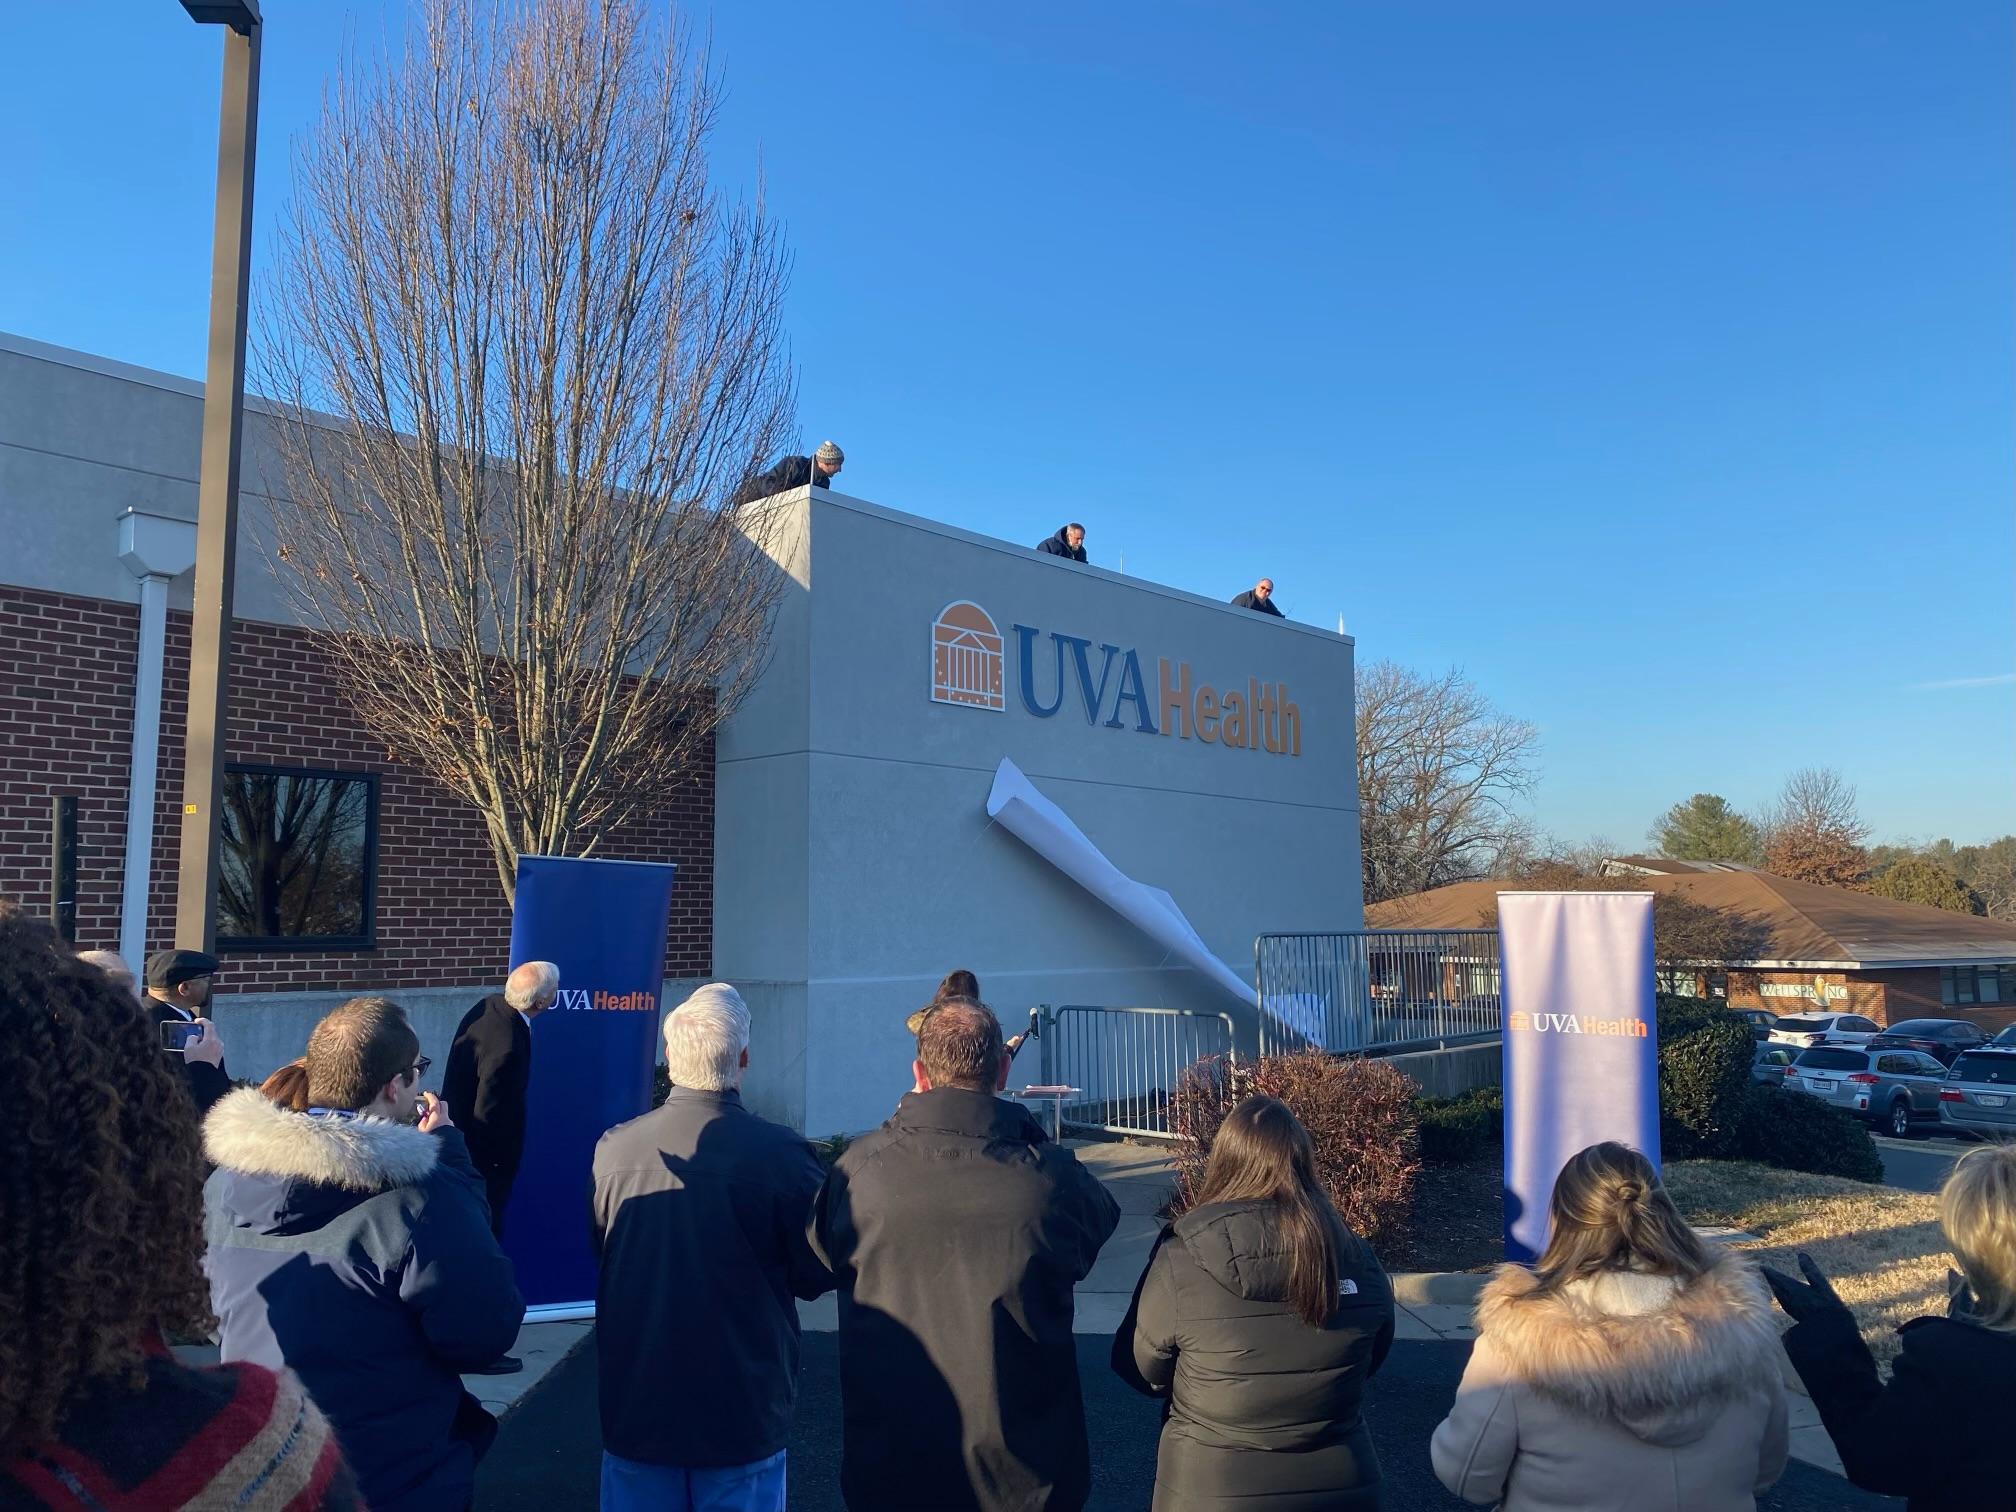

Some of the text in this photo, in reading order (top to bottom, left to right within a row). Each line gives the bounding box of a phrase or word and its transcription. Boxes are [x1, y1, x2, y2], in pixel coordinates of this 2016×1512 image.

[1011, 623, 1301, 756] UVA Health
[593, 990, 655, 1011] Health
[1531, 1012, 1648, 1037] UVA Health
